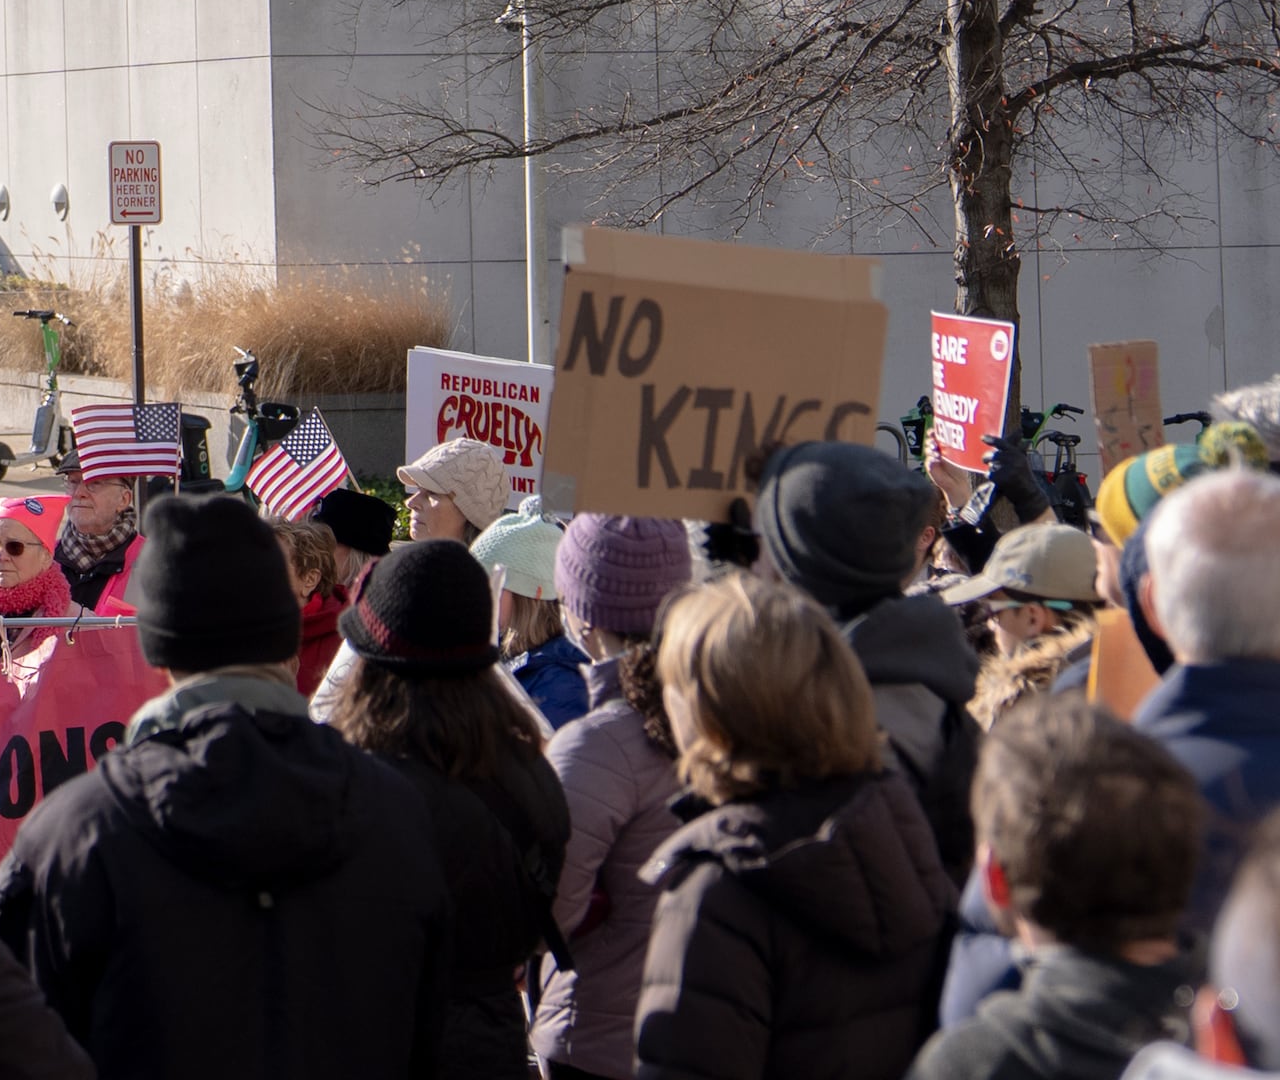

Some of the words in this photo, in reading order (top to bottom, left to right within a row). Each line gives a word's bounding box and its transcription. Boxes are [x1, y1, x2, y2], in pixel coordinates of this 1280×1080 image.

[125, 149, 145, 165] NO
[113, 167, 158, 183] PARKING
[116, 184, 142, 195] HERE
[144, 184, 156, 195] TO
[117, 196, 156, 208] CORNER
[562, 291, 664, 378] NO
[940, 335, 969, 366] ARE
[441, 372, 540, 404] REPUBLICAN
[934, 388, 979, 425] ENNEDY
[437, 394, 542, 467] CRUELTY
[510, 475, 536, 494] INT
